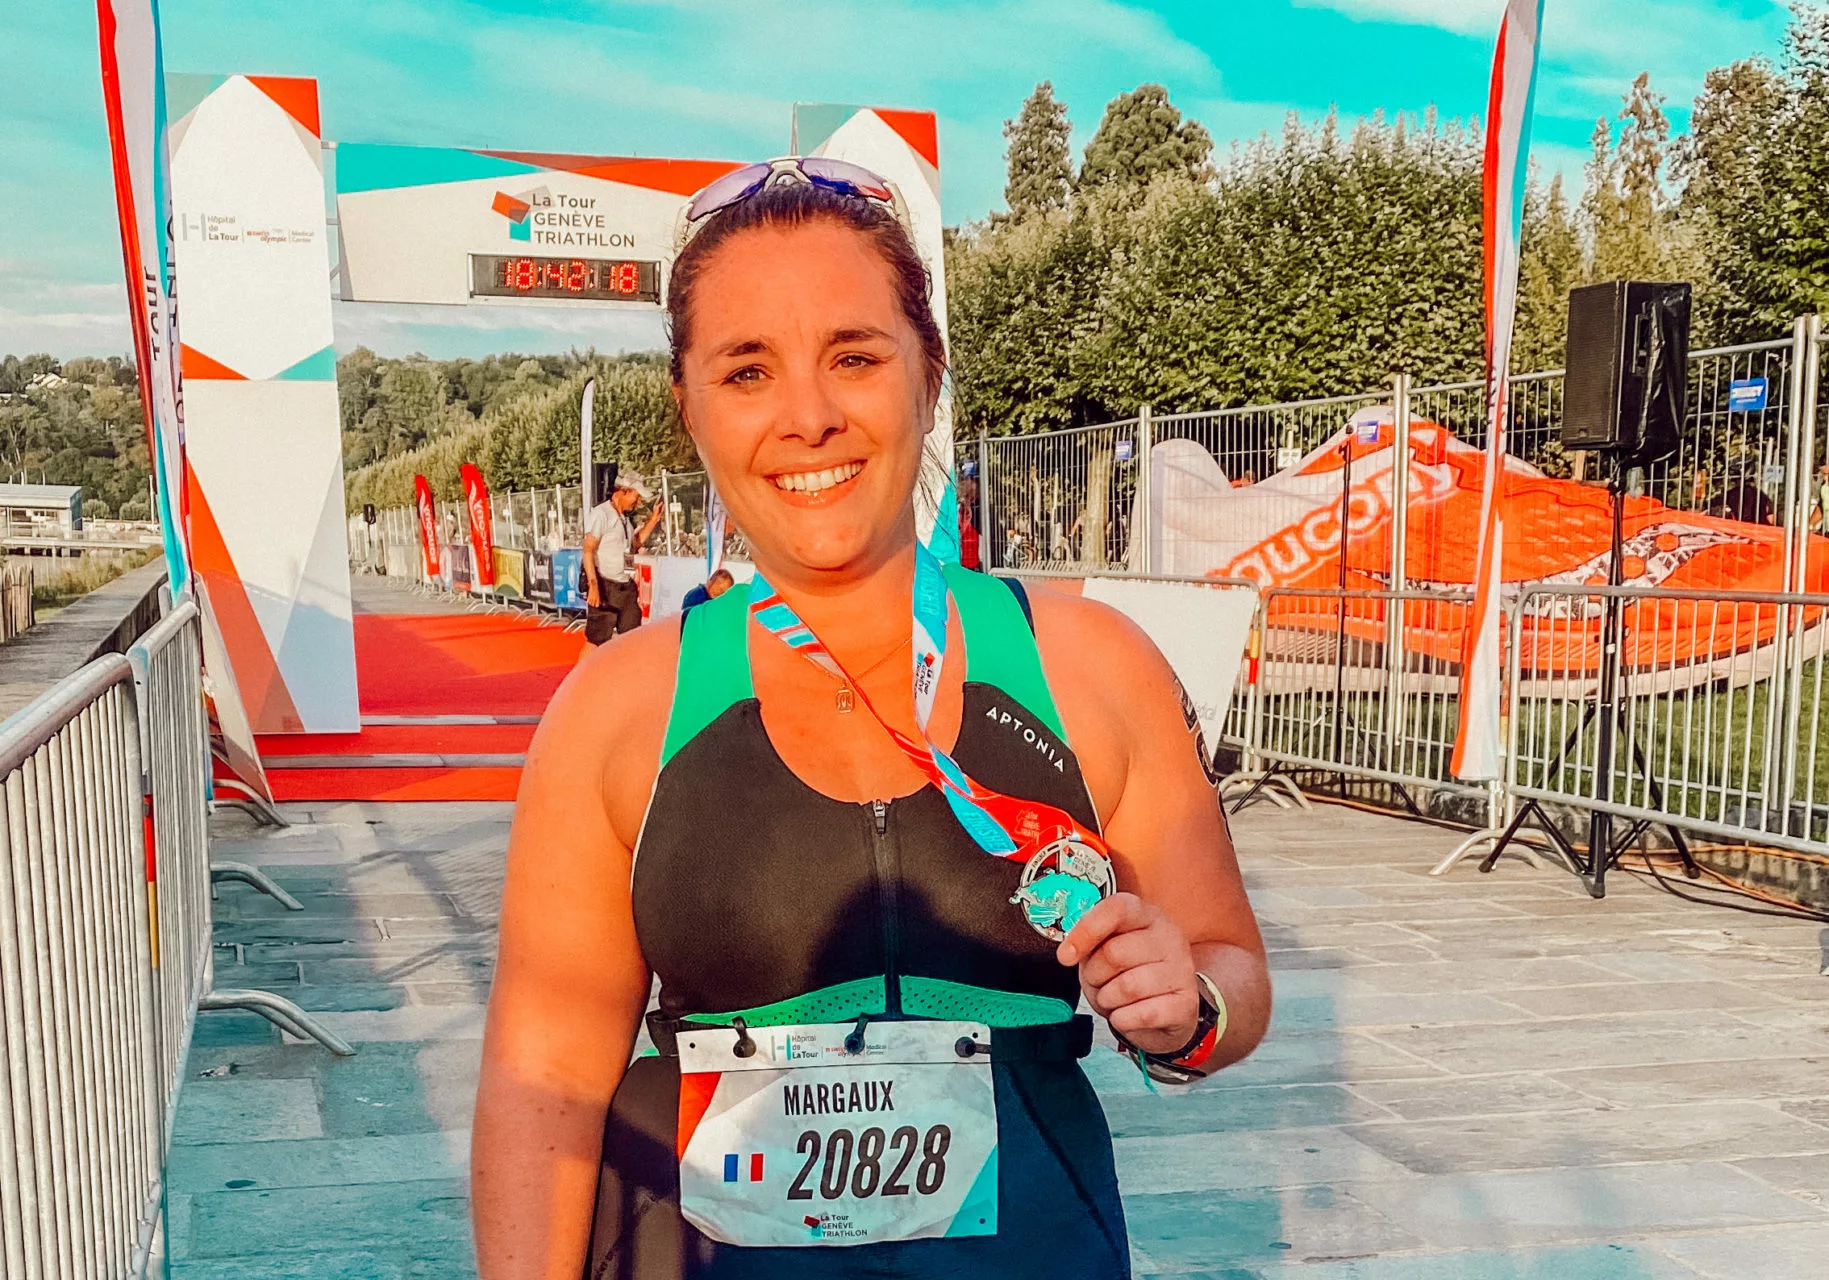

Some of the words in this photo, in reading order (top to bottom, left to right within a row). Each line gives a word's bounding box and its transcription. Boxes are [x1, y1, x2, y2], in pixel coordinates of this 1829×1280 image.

[533, 194, 551, 207] La
[557, 194, 596, 209] Tour
[534, 210, 605, 228] GENÈVE
[208, 233, 219, 241] La
[220, 233, 239, 241] Tour
[534, 230, 636, 248] TRIATHLON
[985, 706, 1065, 773] APTONIA
[802, 1050, 819, 1058] Tour
[783, 1080, 895, 1116] MARGAUX
[787, 1124, 951, 1201] 20828
[822, 1221, 854, 1229] GENÈVE
[822, 1229, 868, 1238] TRIATHLON
